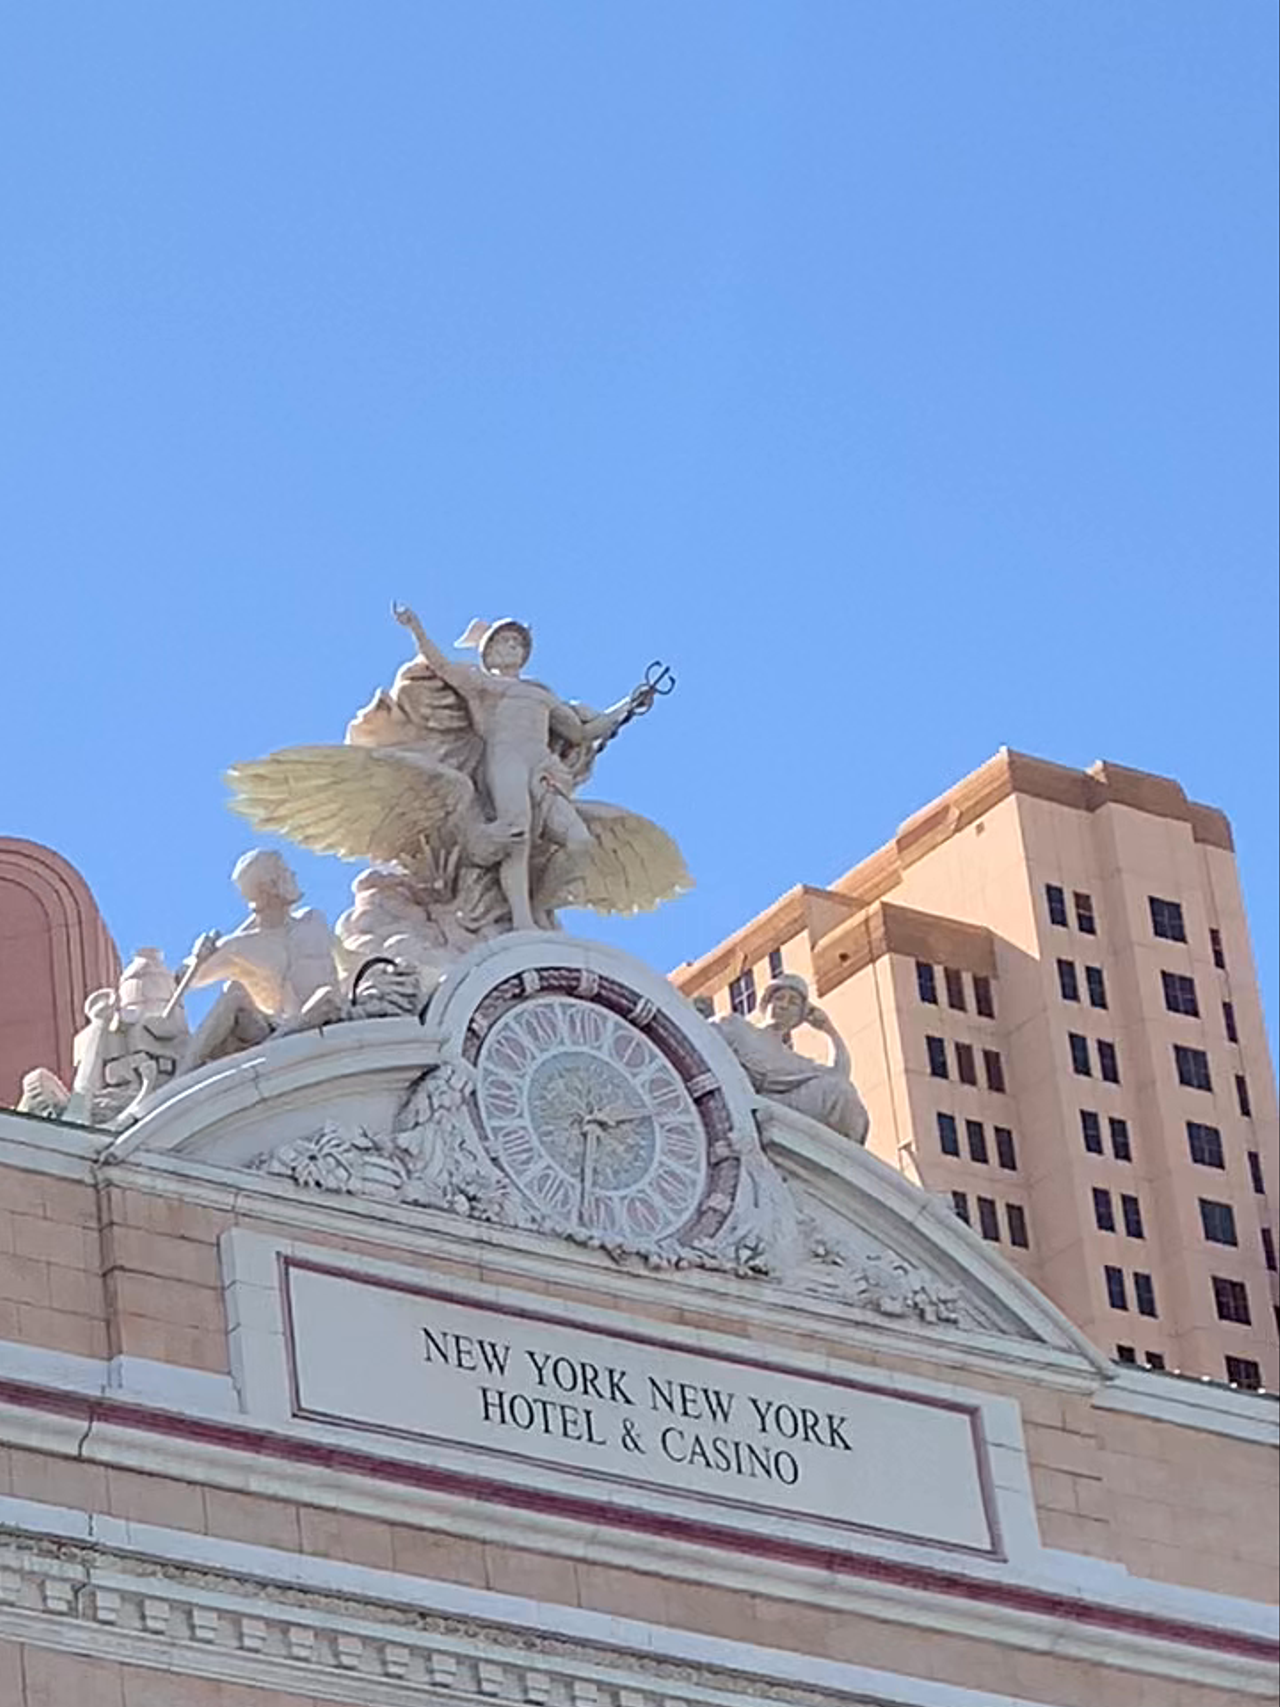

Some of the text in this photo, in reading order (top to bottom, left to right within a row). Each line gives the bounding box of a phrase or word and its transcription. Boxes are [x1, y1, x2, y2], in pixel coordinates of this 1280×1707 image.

[423, 1326, 854, 1452] NEW YORK NEW YORK
[480, 1386, 799, 1486] HOTEL & CASINO
